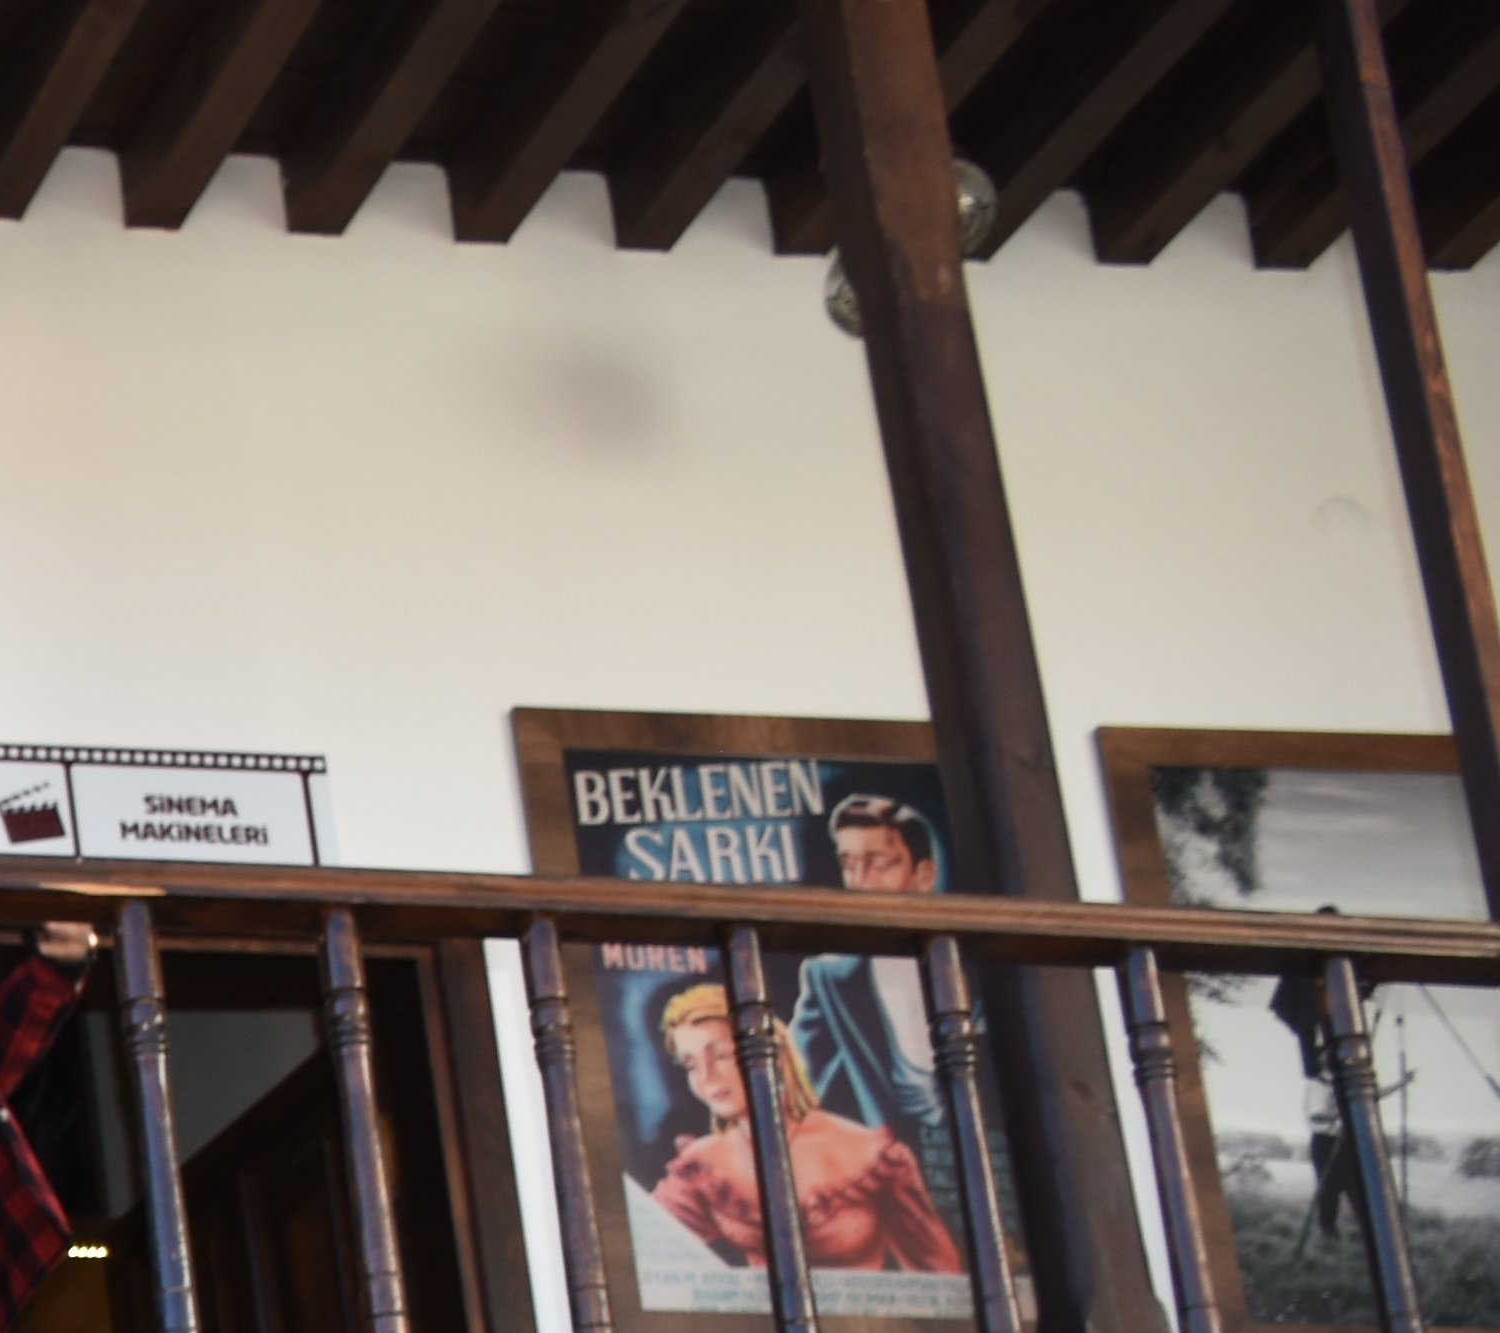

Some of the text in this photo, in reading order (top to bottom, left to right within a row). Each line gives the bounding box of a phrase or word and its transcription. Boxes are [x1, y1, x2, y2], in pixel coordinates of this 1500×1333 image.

[143, 794, 238, 818] SİNEMA
[573, 759, 826, 826] BEKLENEN
[119, 820, 269, 847] MAKİNELERİ
